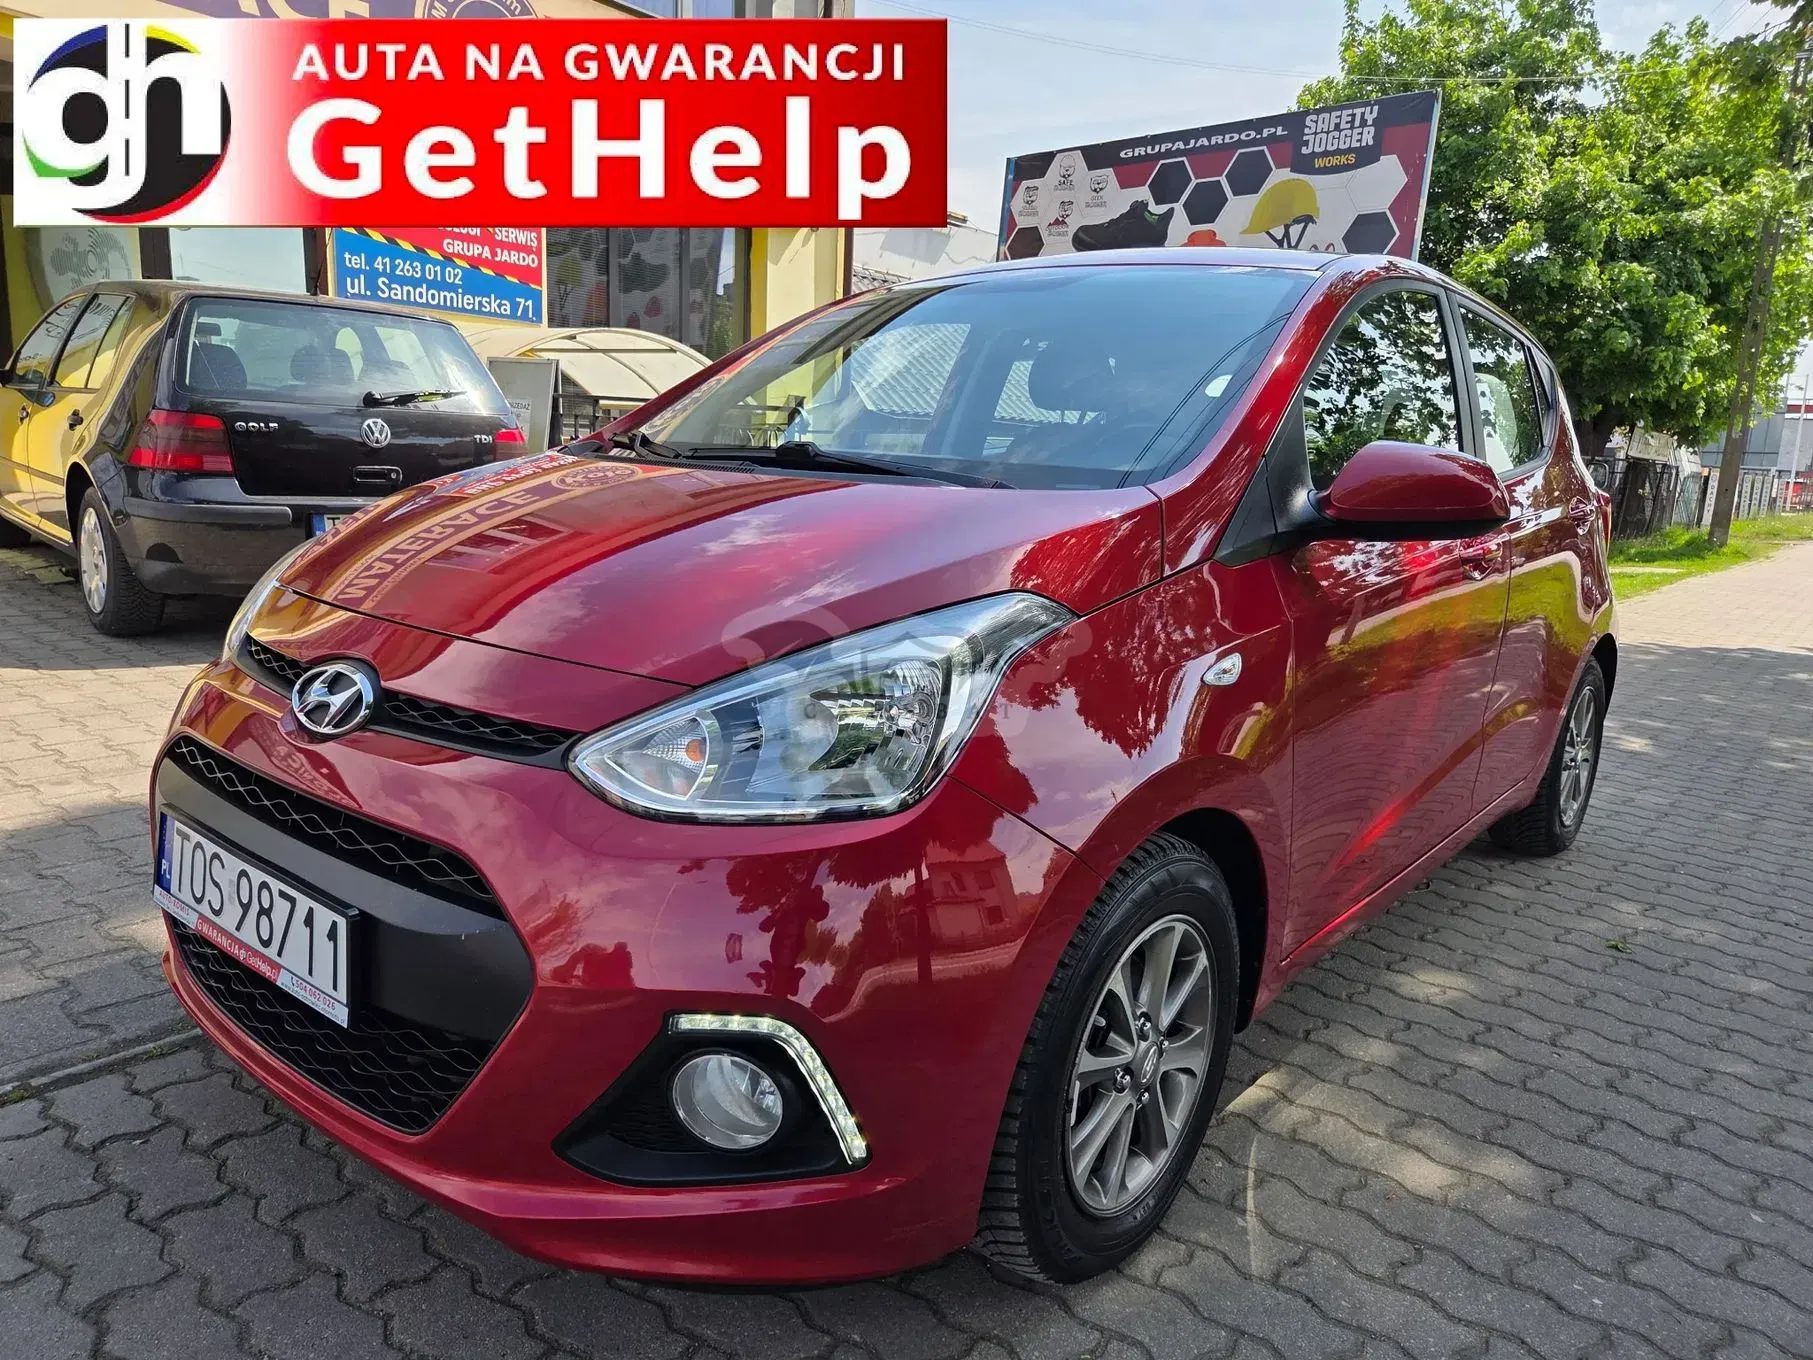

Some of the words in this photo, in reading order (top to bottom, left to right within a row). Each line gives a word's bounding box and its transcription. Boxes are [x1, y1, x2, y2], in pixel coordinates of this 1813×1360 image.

[1304, 105, 1379, 134] SAFETY
[1119, 126, 1288, 158] GRUPAJARDO.PL
[1301, 126, 1375, 154] JOGGER
[1315, 153, 1356, 168] WORKS
[495, 227, 538, 247] SERWIS
[344, 251, 370, 271] tel.
[374, 256, 391, 273] 41
[395, 259, 421, 278] 263
[425, 264, 441, 281] 01
[445, 267, 462, 285] 02
[443, 239, 492, 260] GRUPA
[494, 248, 538, 268] JARDO
[346, 276, 371, 296] ul.
[377, 277, 511, 315] Sandomierska
[234, 421, 279, 432] GOLF
[473, 434, 493, 444] TDI
[161, 859, 171, 879] PL
[175, 826, 225, 917] TOS
[235, 868, 338, 993] 98711
[197, 919, 240, 957] GWARANCJA
